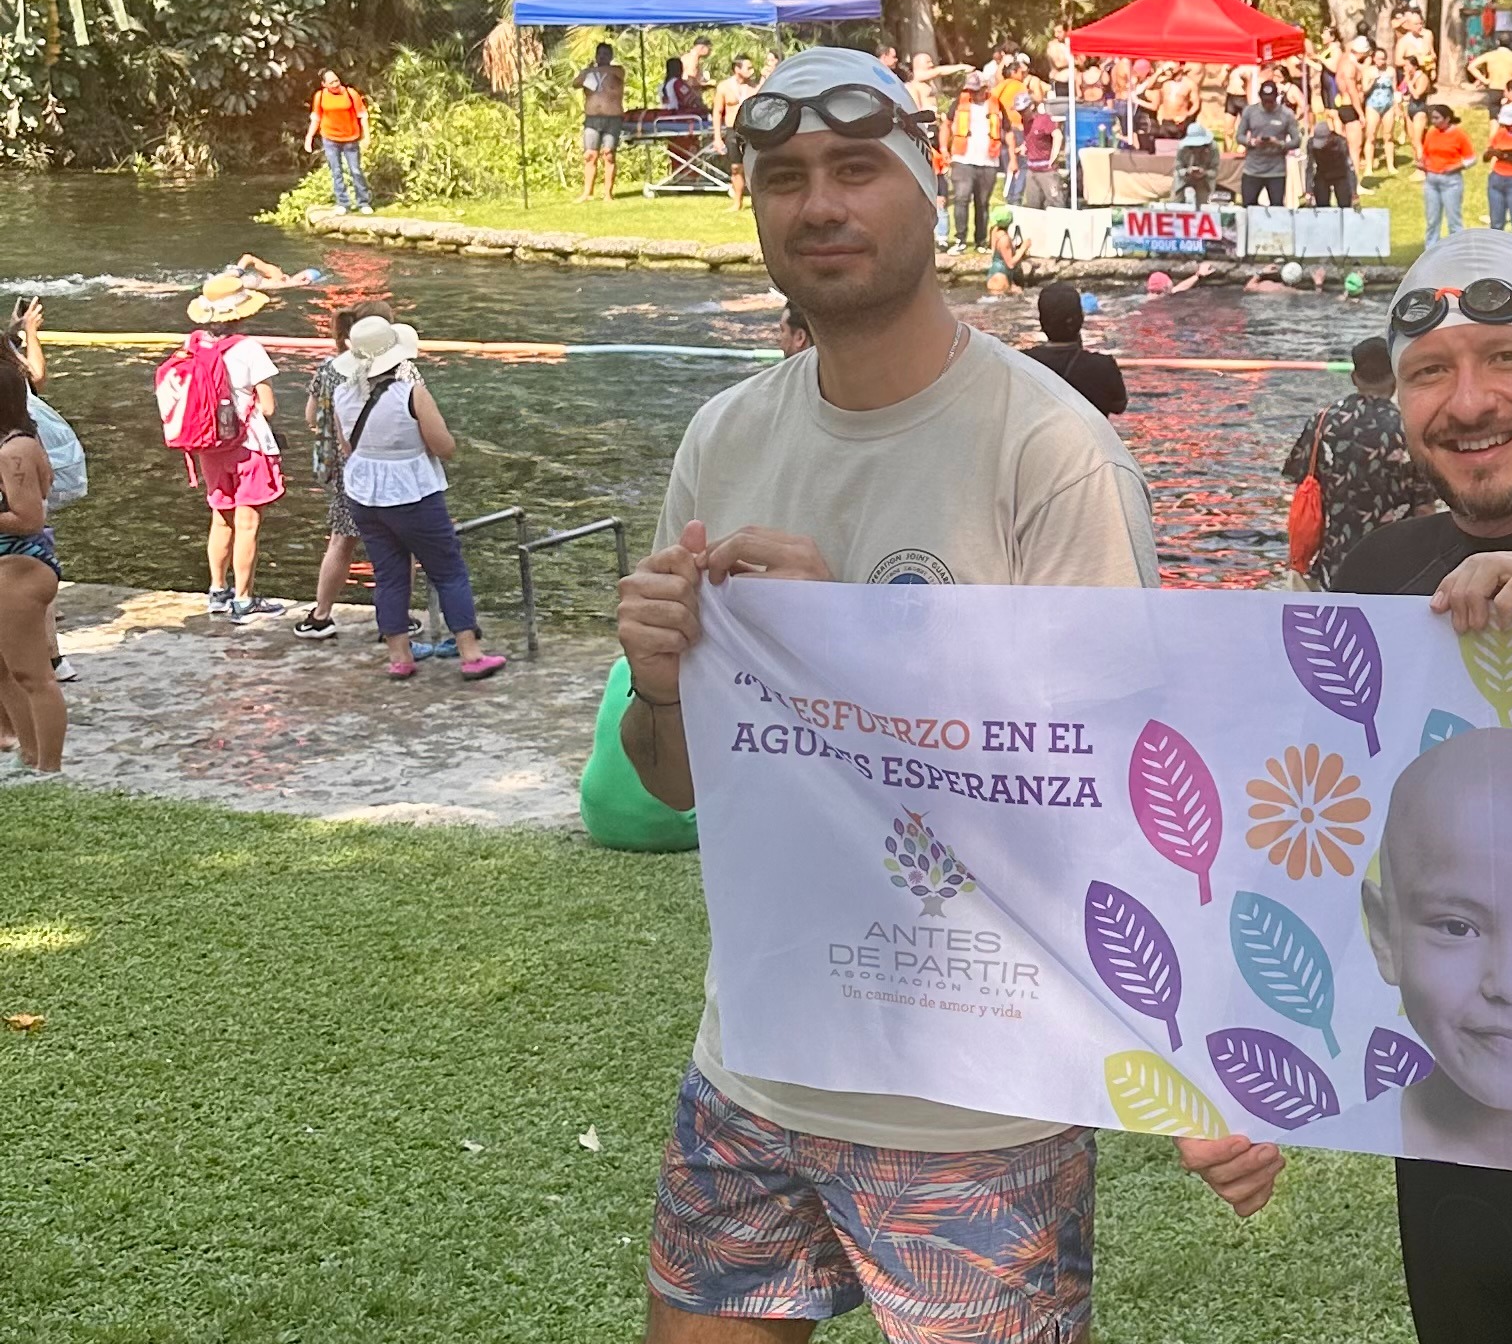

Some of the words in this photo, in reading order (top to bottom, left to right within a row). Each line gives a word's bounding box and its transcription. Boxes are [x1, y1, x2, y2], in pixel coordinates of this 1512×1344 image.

[1127, 212, 1219, 238] META
[931, 561, 951, 584] GUAR
[788, 696, 971, 750] ESFUERZO
[982, 720, 1037, 753] EN
[1048, 722, 1094, 755] EL
[881, 756, 1103, 808] ESPERANZA
[864, 921, 1002, 954] ANTES
[829, 943, 881, 969] DE
[894, 951, 1040, 987] PARTIR
[829, 968, 962, 992] ASOCIACIÓN
[979, 985, 1040, 1000] CIVIL
[842, 984, 862, 999] Un
[865, 989, 916, 1006] camino
[919, 993, 936, 1008] de
[939, 1000, 976, 1013] amor
[978, 1005, 988, 1018] y
[992, 1004, 1023, 1019] vida
